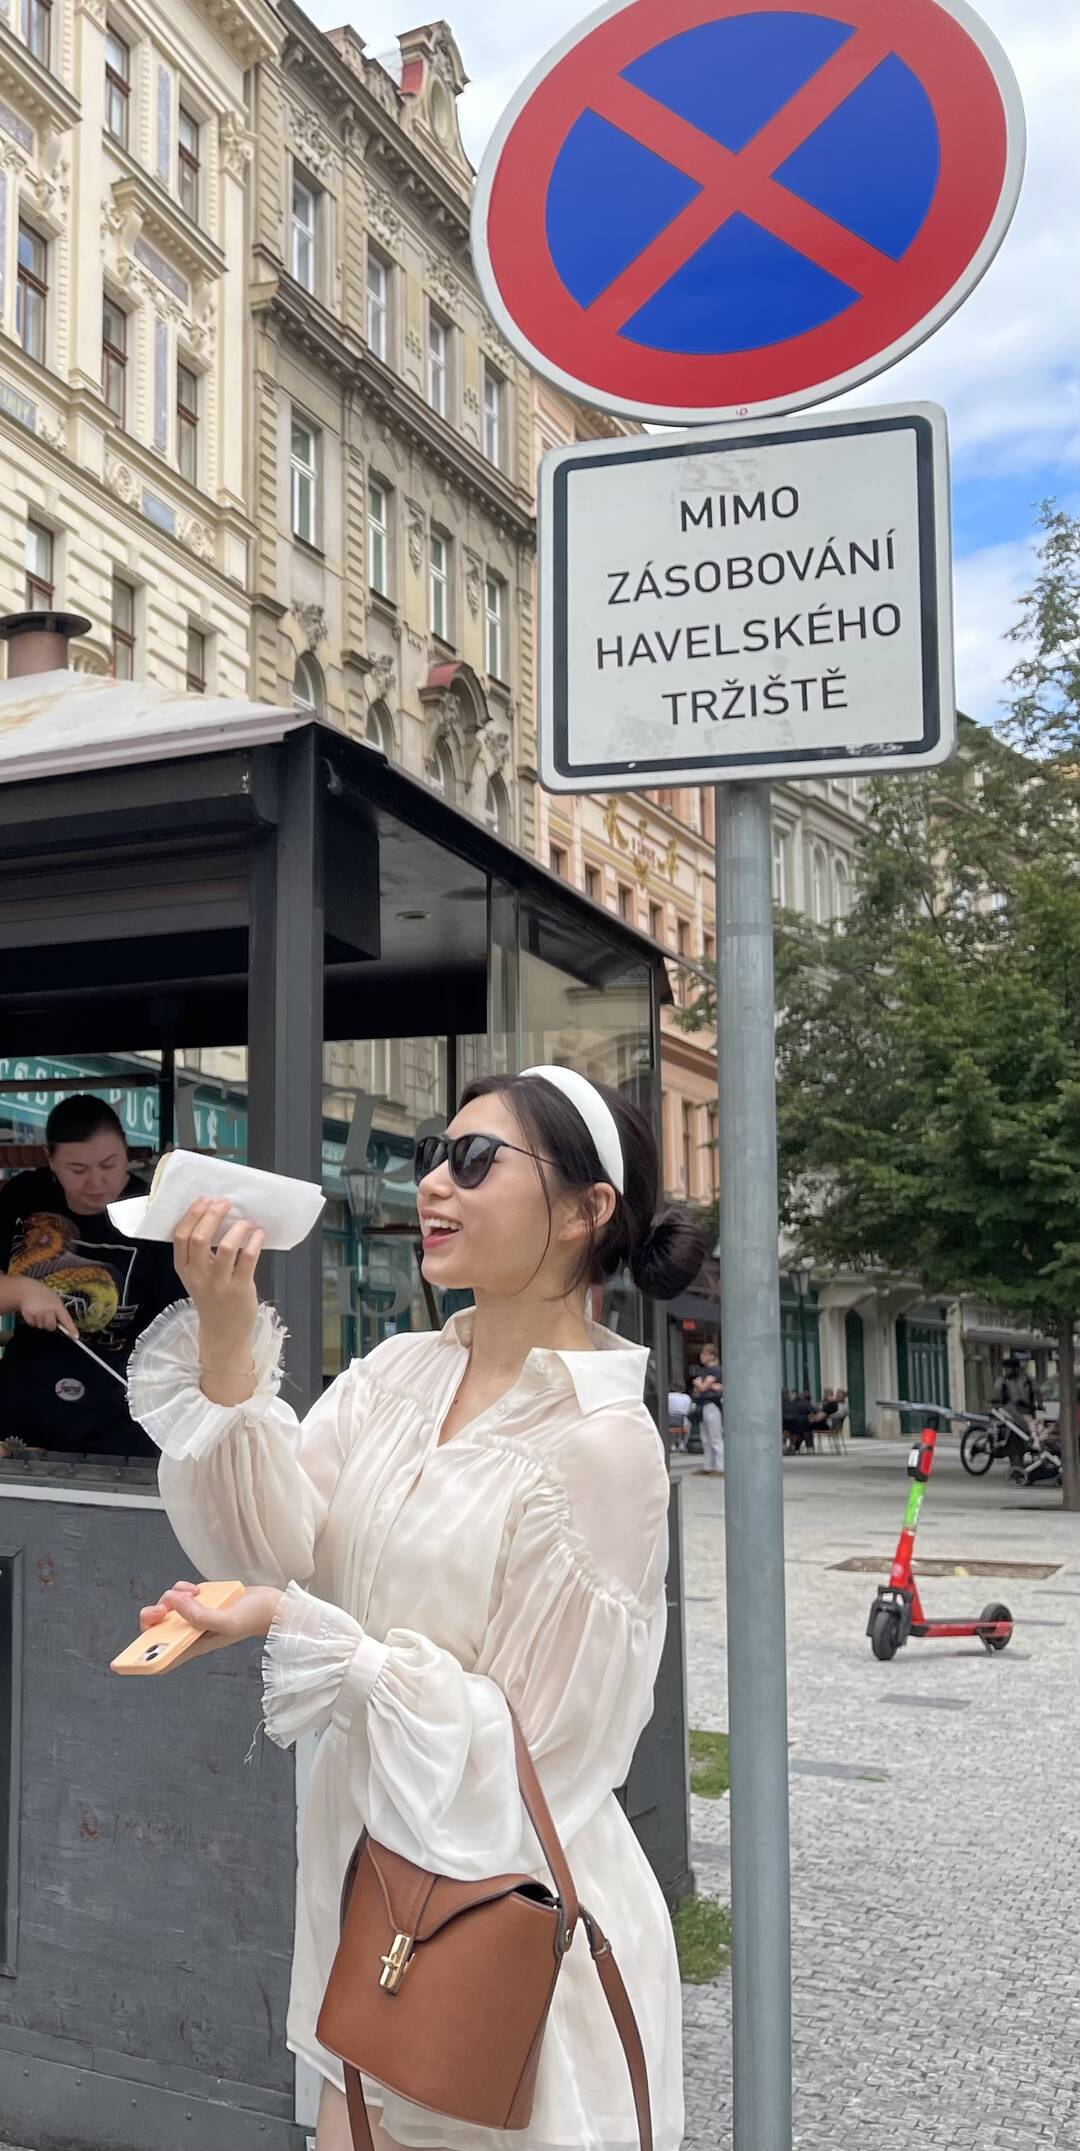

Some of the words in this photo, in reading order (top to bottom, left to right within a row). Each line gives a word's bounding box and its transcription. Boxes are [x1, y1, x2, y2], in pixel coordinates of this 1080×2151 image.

[680, 486, 799, 532] MIMO
[607, 528, 896, 605] ZÁSOBOVÁNÍ
[597, 603, 901, 670] HAVELSKÉHO
[661, 667, 848, 725] TRŽIŠTĚ
